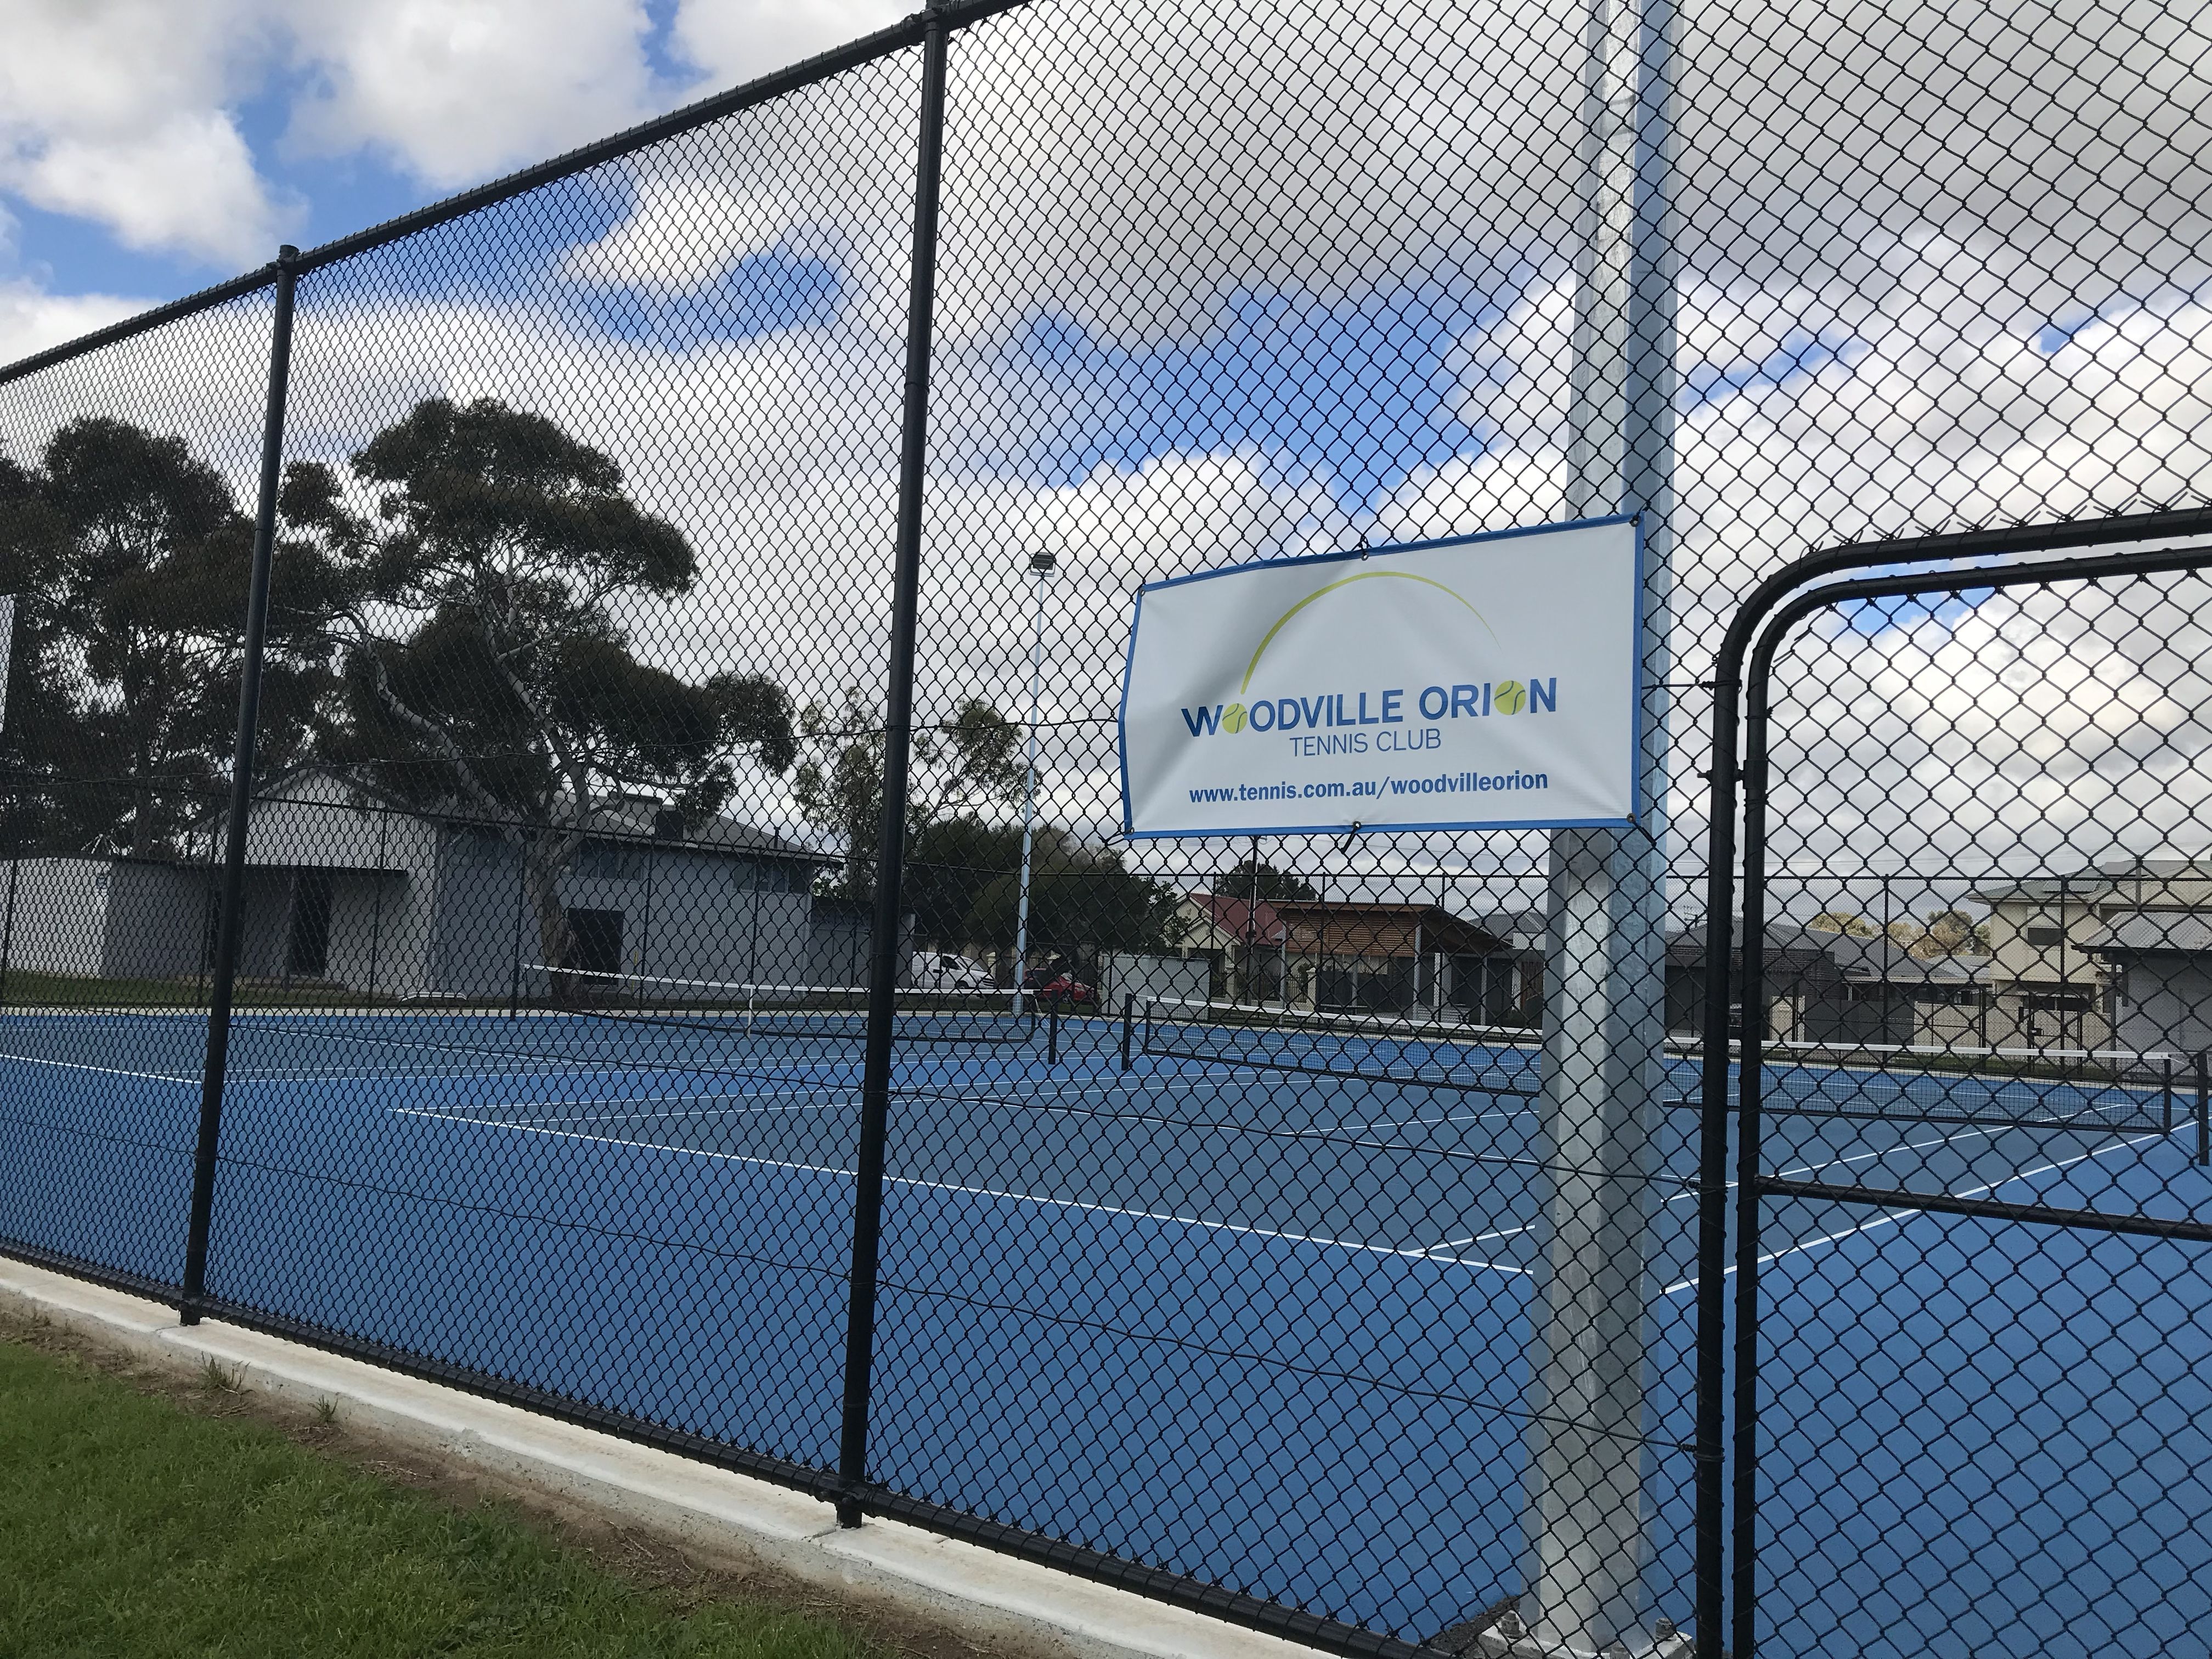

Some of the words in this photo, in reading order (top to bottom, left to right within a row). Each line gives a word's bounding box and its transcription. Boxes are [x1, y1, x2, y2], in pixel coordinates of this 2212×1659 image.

[1181, 689, 1404, 737] WOODVILLE
[1419, 677, 1557, 720] ORION
[1289, 732, 1368, 757] TENNIS
[1375, 728, 1441, 752] CLUB
[1189, 771, 1549, 804] www.tennis.com.au/woodvilleorion
